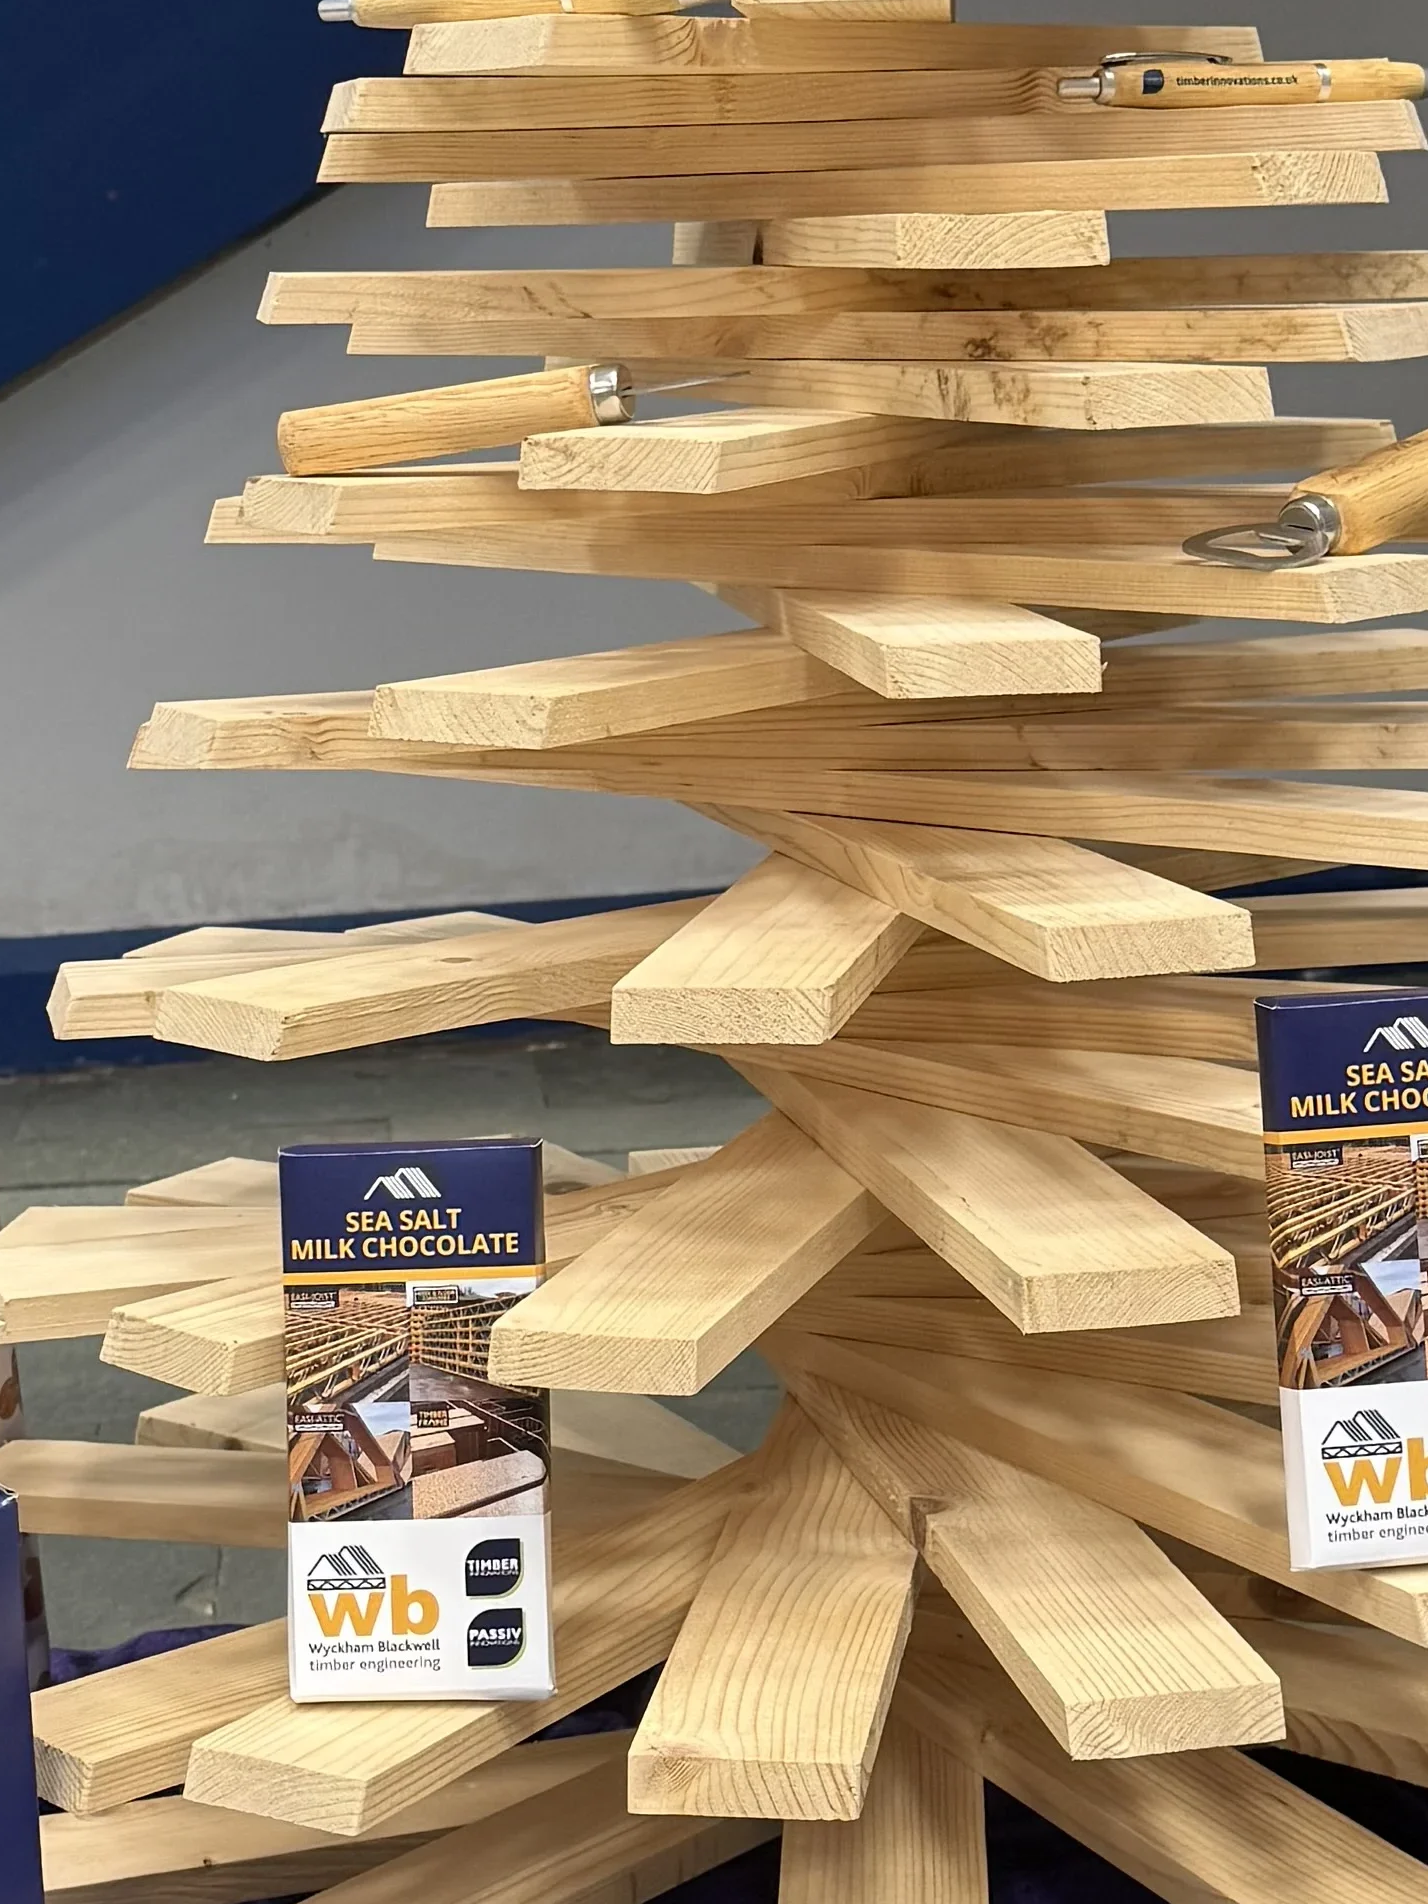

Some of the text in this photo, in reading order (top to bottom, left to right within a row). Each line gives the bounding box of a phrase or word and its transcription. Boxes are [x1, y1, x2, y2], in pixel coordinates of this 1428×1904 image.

[1345, 1062, 1395, 1087] SEA
[1290, 1092, 1358, 1119] MILK
[345, 1207, 463, 1233] SEA SALT
[290, 1231, 520, 1261] MILK CHOCOLATE
[1325, 1509, 1394, 1528] Wyckham
[1327, 1528, 1375, 1543] timber
[466, 1558, 519, 1572] TIMBER
[307, 1574, 441, 1638] wb
[468, 1627, 523, 1641] PASSIV
[308, 1638, 441, 1658] Wyckham Blackwell
[309, 1657, 441, 1673] timber engineering
